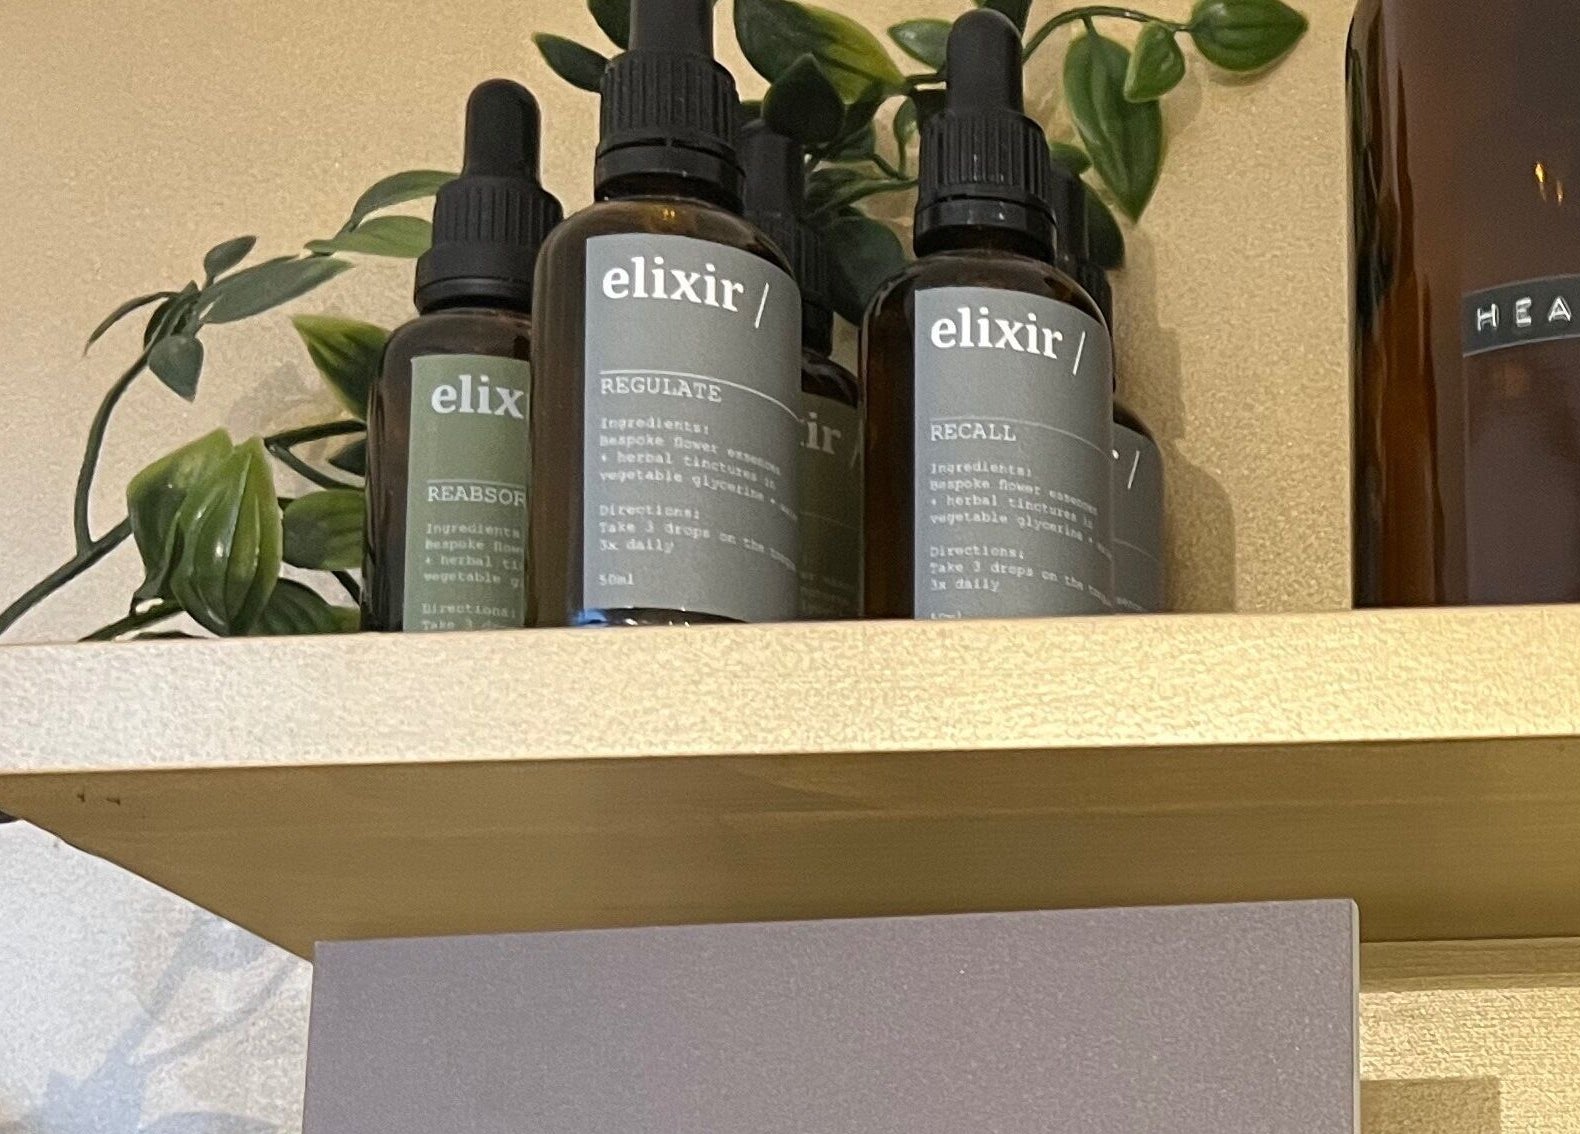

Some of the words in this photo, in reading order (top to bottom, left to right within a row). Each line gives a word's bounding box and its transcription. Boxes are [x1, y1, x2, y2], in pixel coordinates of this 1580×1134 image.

[602, 255, 744, 312] elixir
[930, 306, 1063, 360] elixir
[431, 374, 525, 420] elix
[601, 376, 722, 403] REGULATE
[601, 416, 710, 436] Ingredients:
[930, 422, 1017, 442] RECALL
[427, 485, 527, 507] REABSOR
